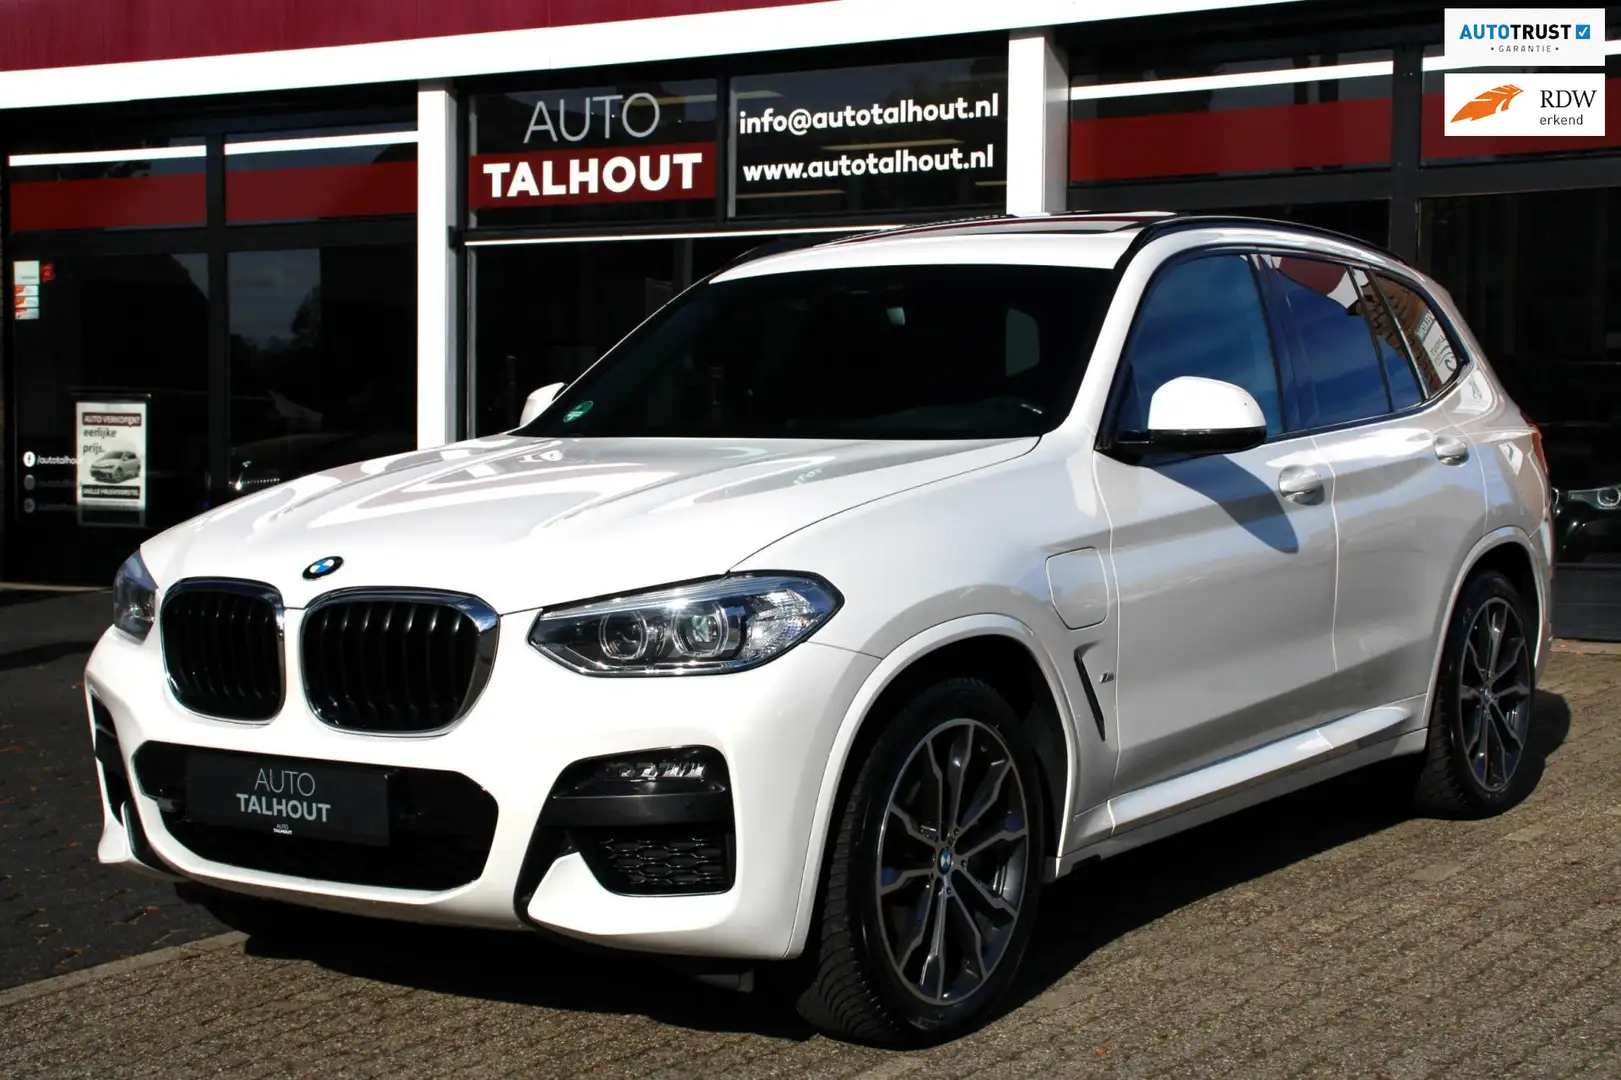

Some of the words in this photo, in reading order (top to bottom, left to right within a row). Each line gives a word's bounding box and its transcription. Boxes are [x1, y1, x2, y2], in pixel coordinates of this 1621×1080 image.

[523, 92, 660, 143] AUTO
[740, 93, 999, 135] info@autotalhout.nl
[483, 152, 703, 198] TALHOUT
[743, 144, 994, 182] www.autotalhout.nl
[83, 428, 117, 439] eerlijke
[254, 768, 316, 797] AUTO
[236, 793, 331, 823] TALHOUT
